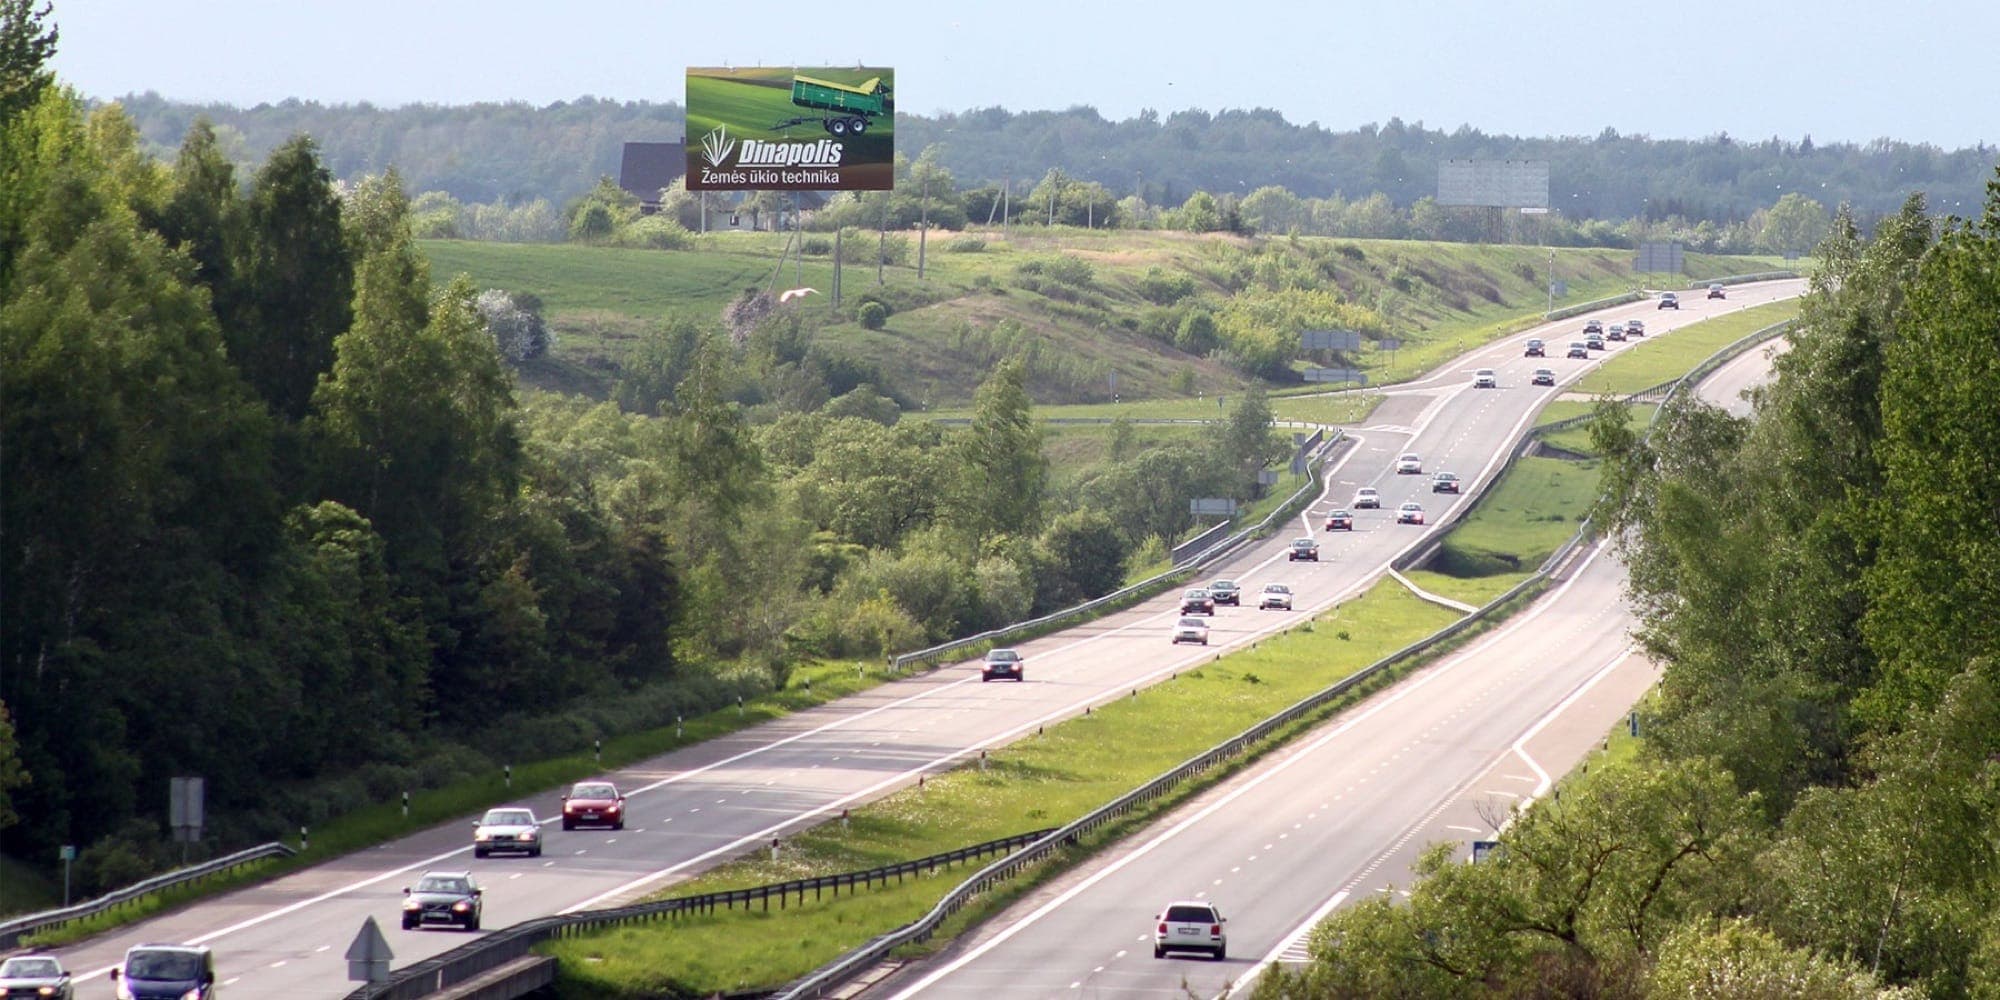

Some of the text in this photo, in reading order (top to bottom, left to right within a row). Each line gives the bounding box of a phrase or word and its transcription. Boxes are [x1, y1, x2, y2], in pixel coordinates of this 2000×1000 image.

[738, 139, 843, 166] Dinapolis
[701, 167, 840, 184] Žemės ūkio technika
